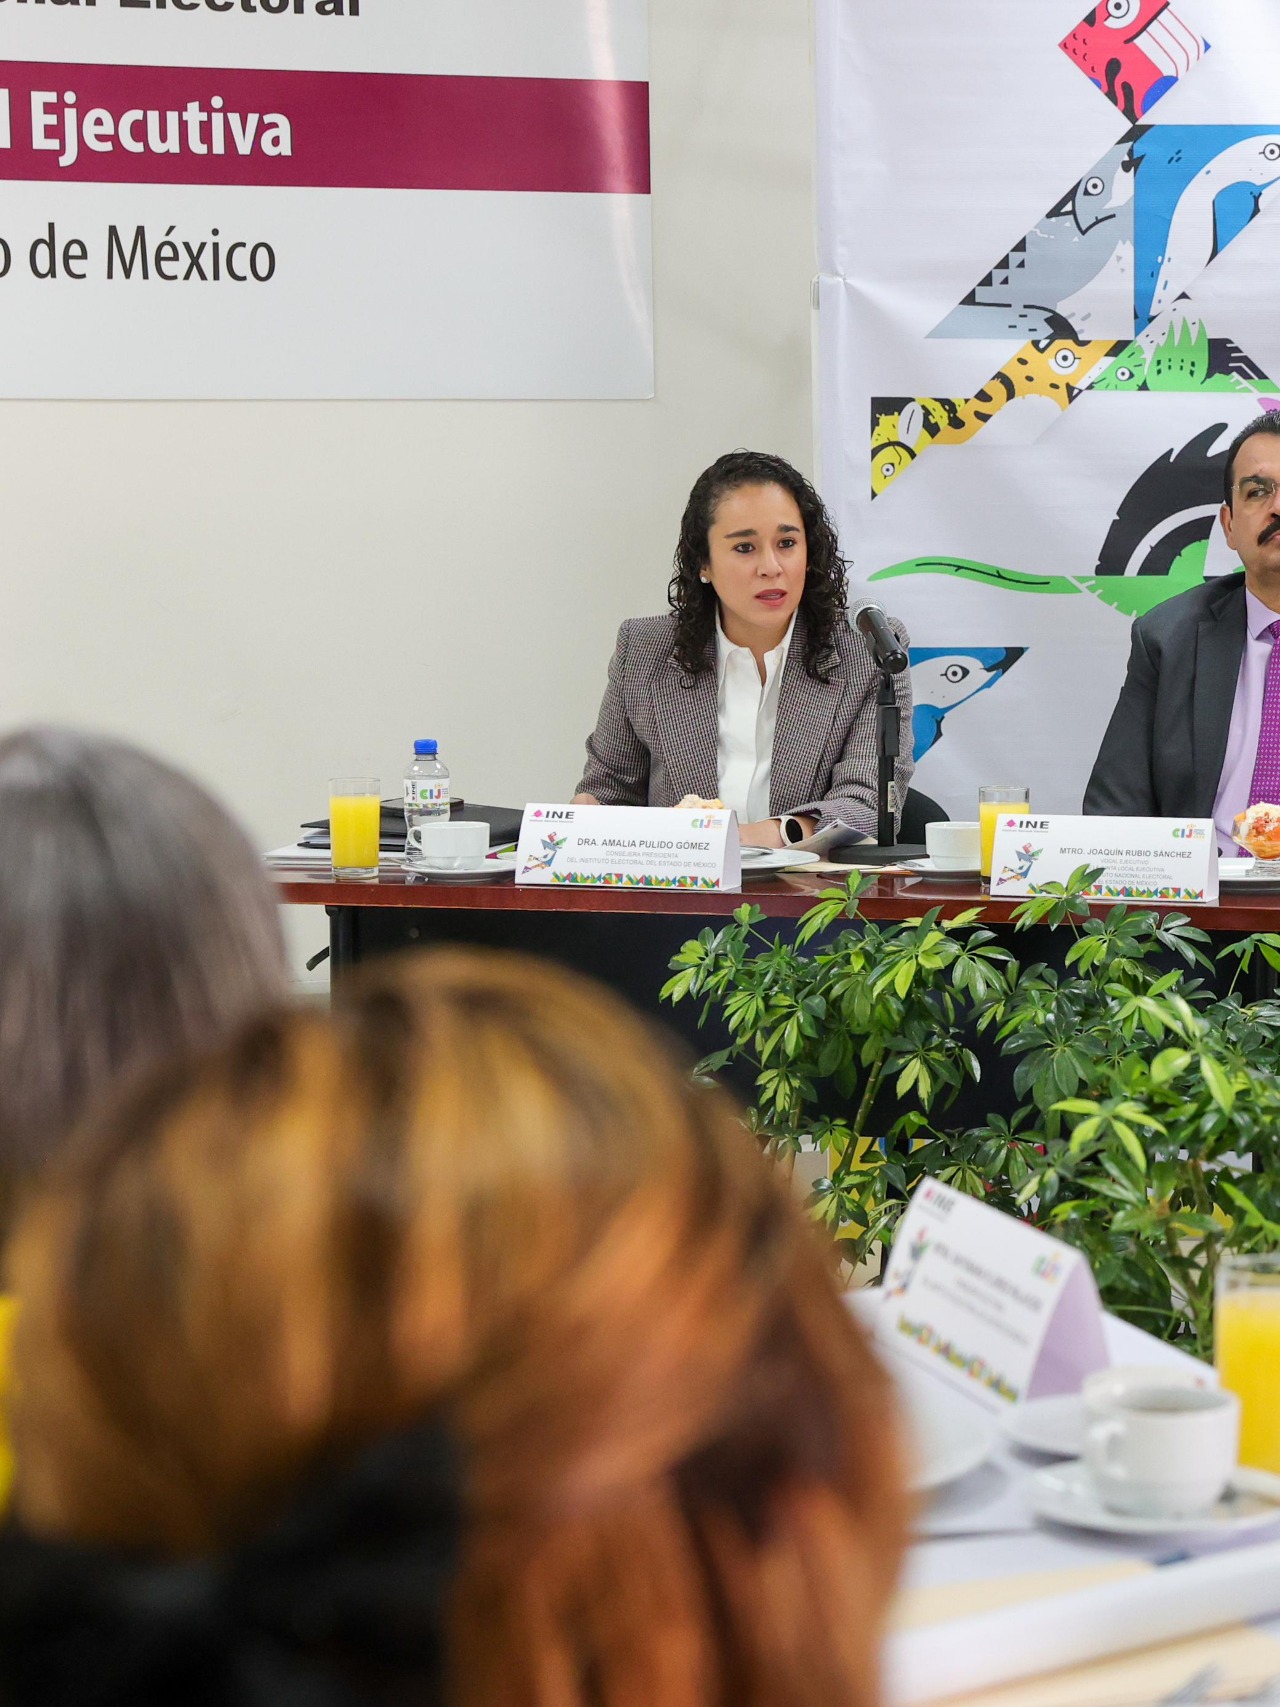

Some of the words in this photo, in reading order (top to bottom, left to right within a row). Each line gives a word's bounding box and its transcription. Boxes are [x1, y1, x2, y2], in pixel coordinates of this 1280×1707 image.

[31, 90, 294, 168] Ejecutiva
[29, 222, 88, 279] de
[106, 224, 276, 282] México
[420, 788, 442, 800] CIJ
[545, 810, 575, 820] INE
[691, 818, 712, 828] CIJ
[1018, 820, 1050, 830] INE
[1172, 828, 1192, 838] CIJ
[577, 838, 599, 846] DRA.
[602, 838, 637, 848] AMALIA
[638, 840, 674, 850] PULIDO
[1060, 847, 1085, 855] MTRO.
[1087, 848, 1124, 857] JOAQUÍN
